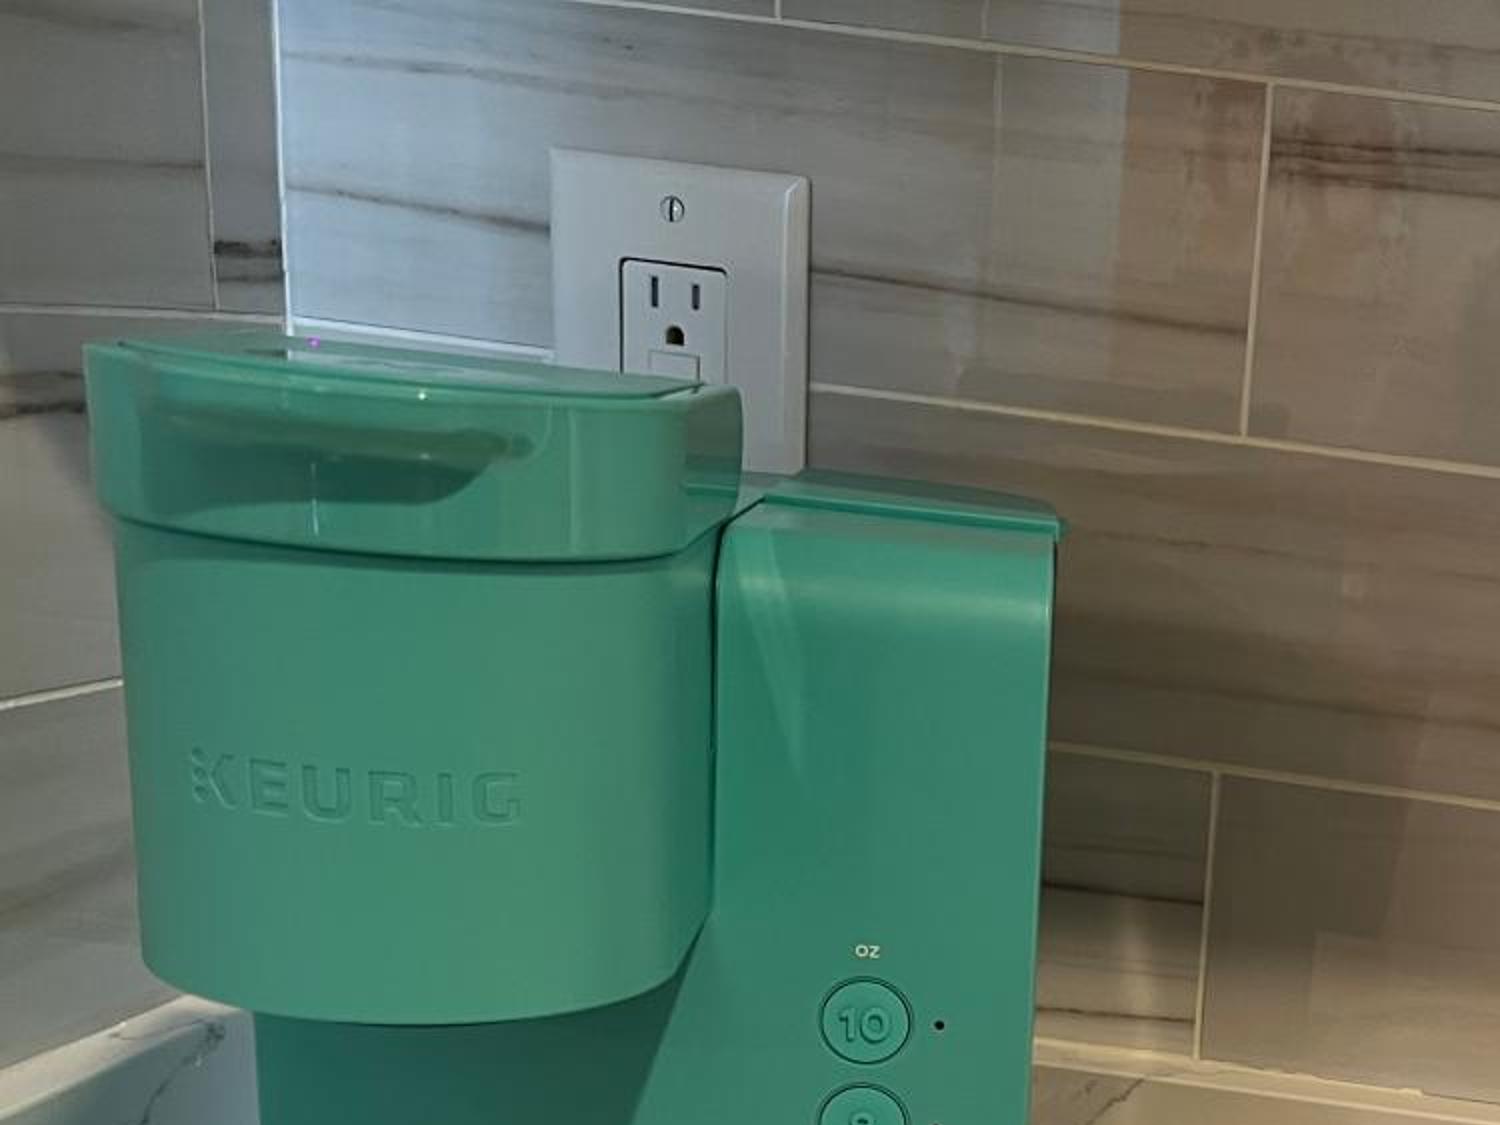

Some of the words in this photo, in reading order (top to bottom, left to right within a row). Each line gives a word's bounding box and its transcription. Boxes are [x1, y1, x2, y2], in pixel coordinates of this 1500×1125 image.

[191, 747, 523, 828] KEURIG
[855, 944, 880, 959] OZ
[838, 1006, 892, 1044] 10
